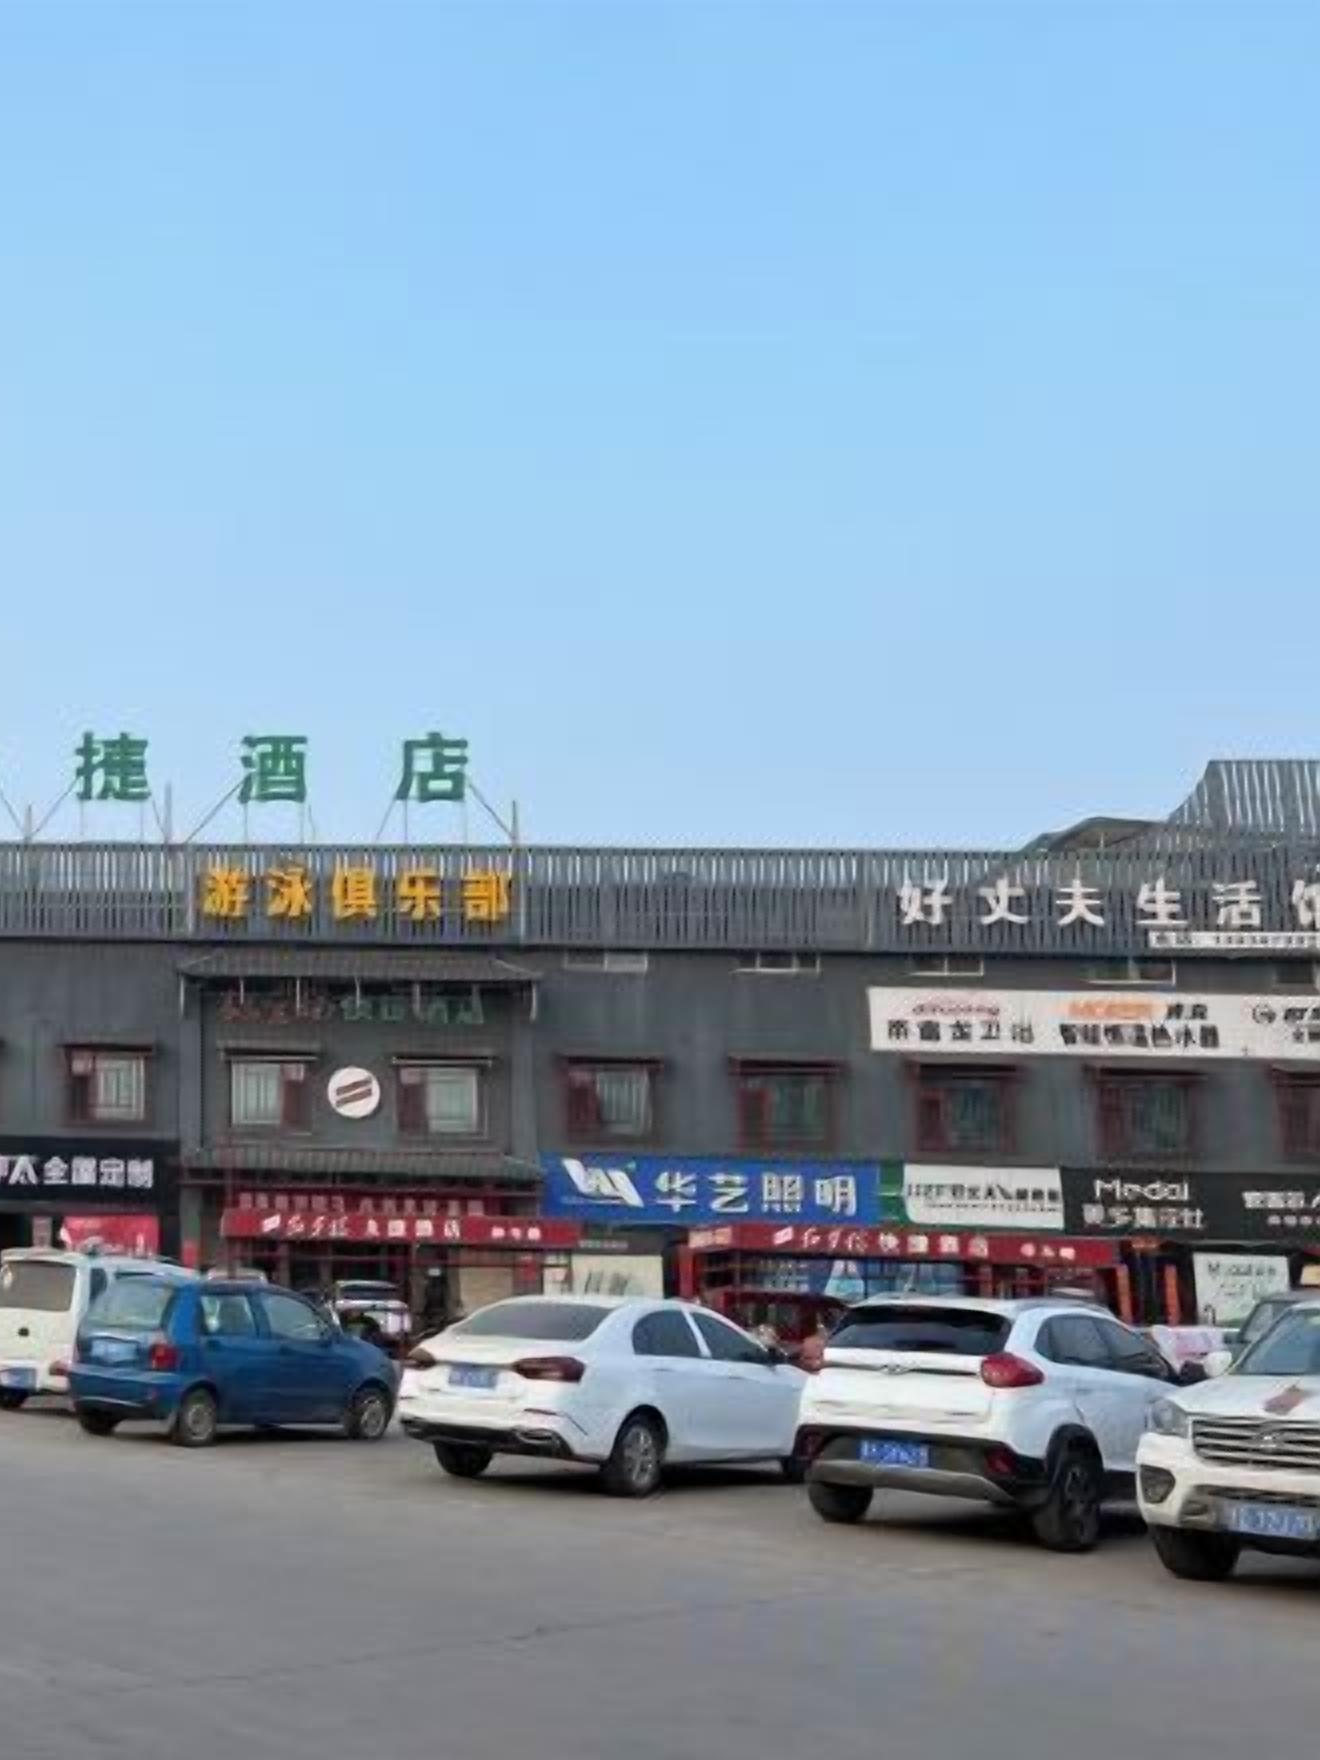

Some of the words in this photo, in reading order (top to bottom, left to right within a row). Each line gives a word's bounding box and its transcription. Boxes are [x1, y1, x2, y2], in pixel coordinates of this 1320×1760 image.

[202, 866, 510, 922] 游泳俱乐部
[653, 1170, 858, 1217] 华艺照明
